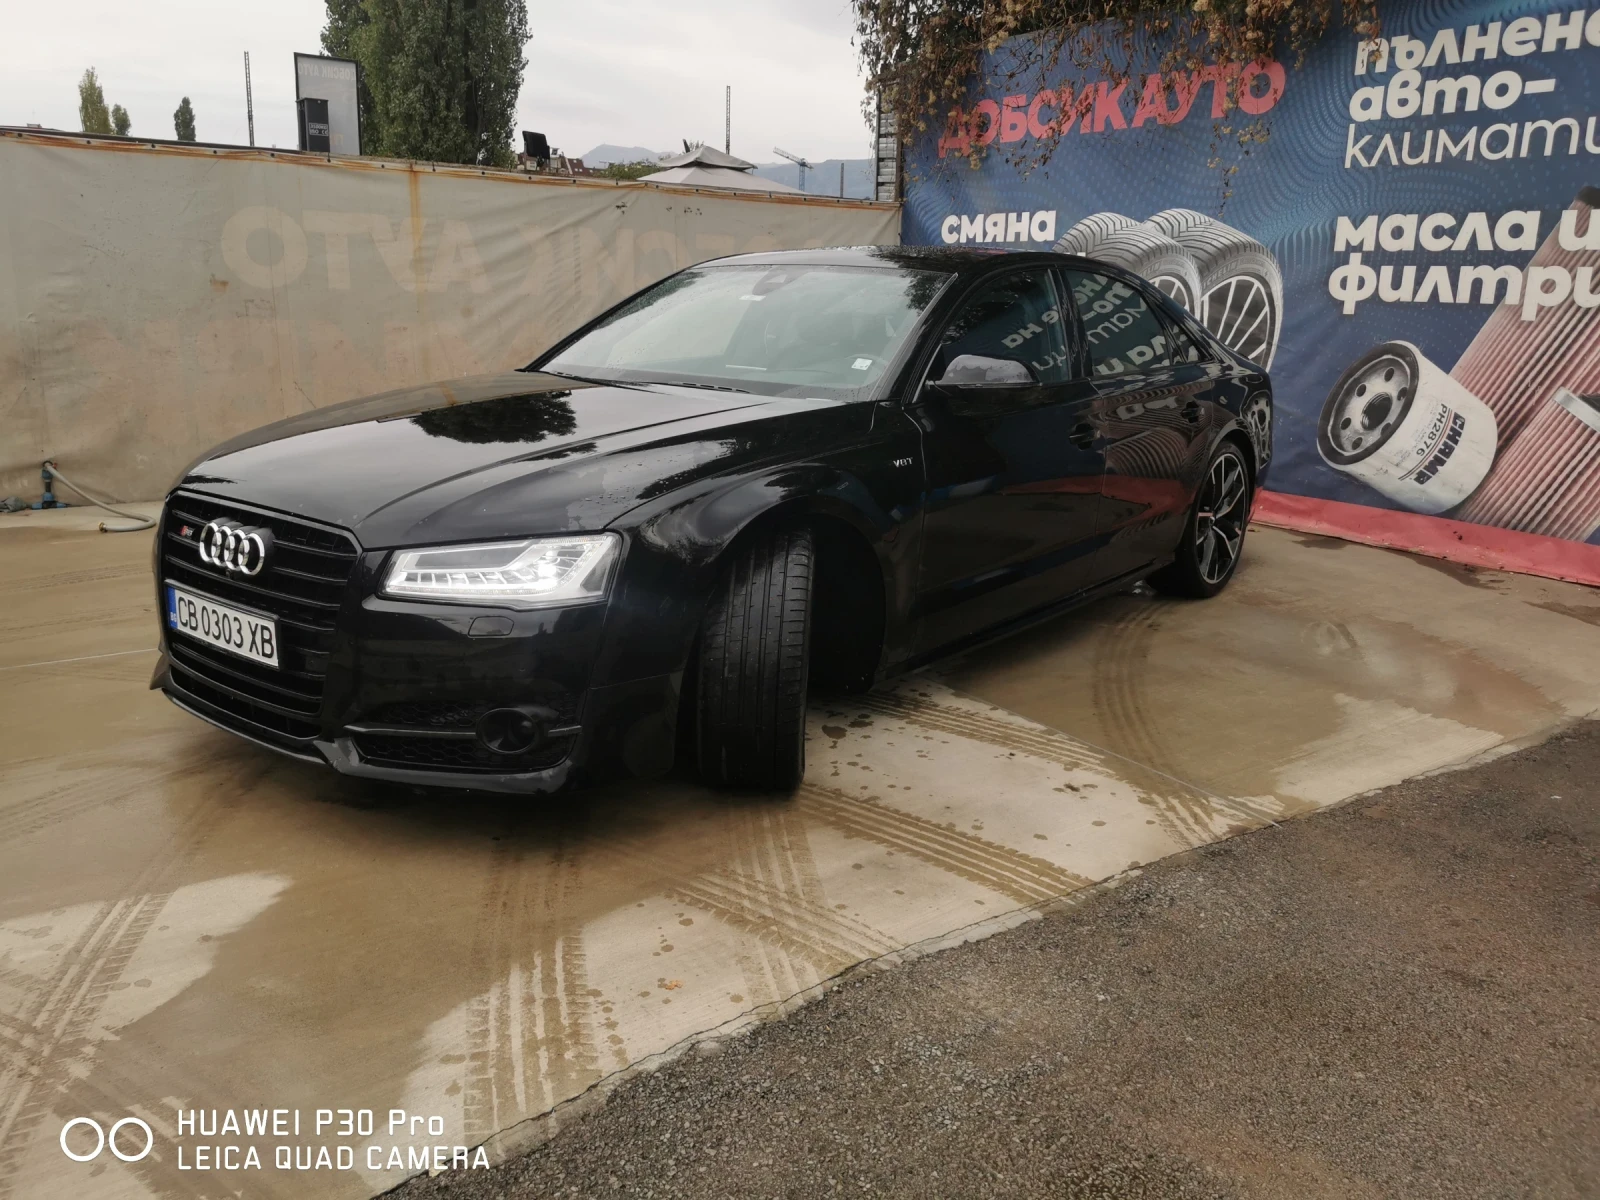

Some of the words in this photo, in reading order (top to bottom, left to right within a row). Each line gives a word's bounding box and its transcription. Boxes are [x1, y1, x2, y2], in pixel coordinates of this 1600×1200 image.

[1350, 69, 1556, 122] авто-
[941, 210, 1057, 244] смяна
[1334, 210, 1541, 252] масла
[1202, 258, 1240, 290] ICHELIN
[1416, 403, 1448, 457] PH2876
[178, 596, 199, 632] CB
[201, 606, 244, 649] 0303
[247, 620, 275, 659] XB
